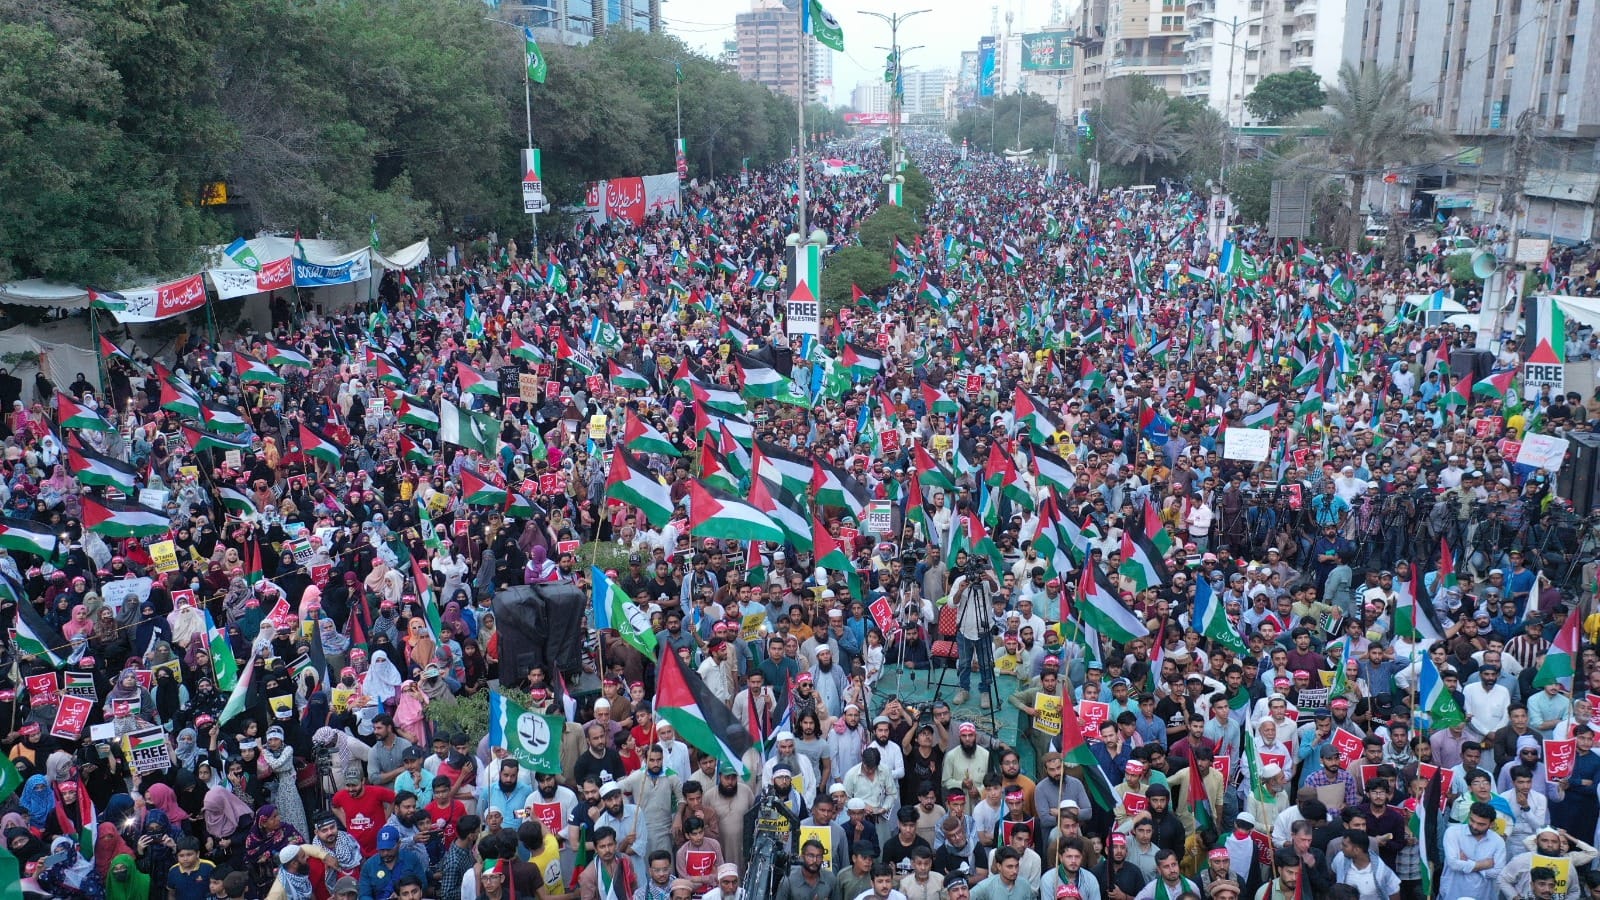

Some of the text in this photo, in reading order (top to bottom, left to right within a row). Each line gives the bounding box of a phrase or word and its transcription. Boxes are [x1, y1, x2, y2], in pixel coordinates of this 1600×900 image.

[523, 182, 541, 190] FREE
[298, 265, 323, 279] SOCIAL
[162, 289, 179, 309] مارچ
[179, 282, 203, 306] فلسطین
[787, 302, 817, 316] FREE
[787, 315, 817, 323] PALESTINE
[1525, 364, 1562, 381] FREE
[869, 513, 891, 523] FREE
[154, 552, 174, 562] STAND
[293, 548, 314, 561] FREE
[66, 686, 96, 695] FREE
[65, 702, 86, 717] لبیک
[1298, 699, 1327, 708] FREE
[1085, 706, 1103, 720] لبیک
[1036, 718, 1058, 729] HAMAS
[133, 744, 168, 761] FREE
[512, 747, 551, 769] جماعت اسلامی
[1552, 744, 1572, 760] لبیک
[135, 755, 169, 767] PALESTINE
[539, 808, 556, 824] لبیک
[692, 856, 712, 876] لبیک
